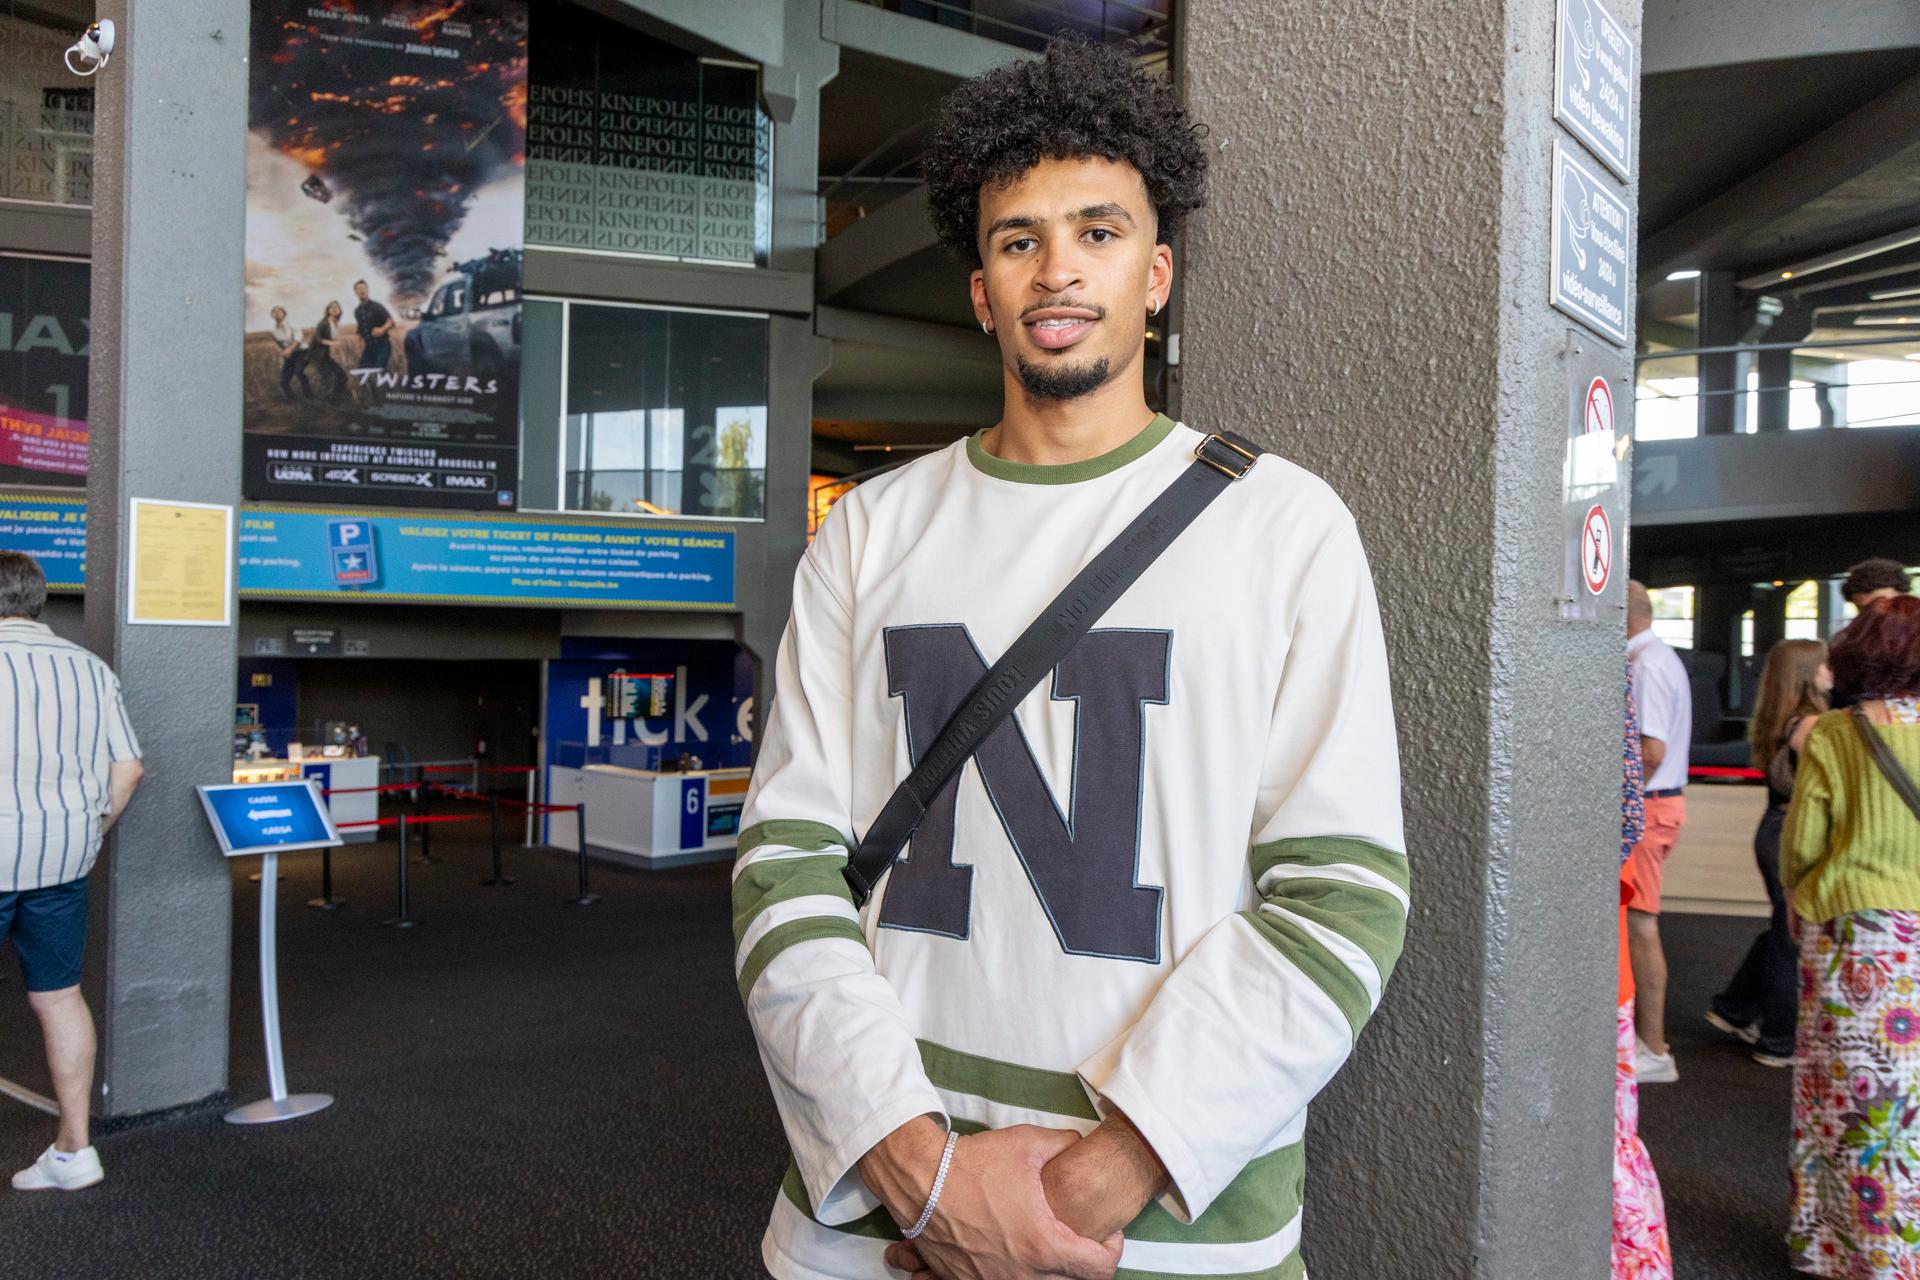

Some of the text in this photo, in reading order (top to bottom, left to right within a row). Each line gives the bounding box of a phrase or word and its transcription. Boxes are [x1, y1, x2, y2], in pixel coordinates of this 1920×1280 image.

[600, 93, 698, 119] KINEPOLIS
[1568, 83, 1591, 120] video
[599, 131, 697, 157] KINEPOLIS
[598, 172, 696, 197] KINEPOLIS
[597, 210, 694, 237] KINEPOLIS
[349, 368, 498, 395] TWISTERS
[46, 383, 70, 432] 1
[331, 443, 436, 460] EXPERIENCE TWISTERS
[689, 425, 718, 466] 2
[291, 450, 317, 462] MORE
[371, 454, 385, 465] AT
[386, 456, 436, 468] KINEPOLIS
[437, 458, 484, 470] BRUSSELS
[273, 469, 315, 481] ULTRA
[324, 467, 361, 484] 4DX
[445, 475, 488, 488] IMAX
[339, 524, 361, 546] P
[450, 528, 490, 540] VOTRE
[492, 529, 531, 541] TICKET
[533, 531, 549, 541] DE
[551, 532, 601, 544] PARKING
[603, 534, 641, 545] AVANT
[643, 535, 680, 547] VOTRE
[682, 535, 726, 549] SÉANCE
[448, 541, 475, 551] Avant
[556, 545, 585, 555] valider
[586, 546, 609, 556] votre
[610, 546, 634, 557] ticket
[635, 547, 646, 557] de
[647, 548, 680, 561] parking
[576, 569, 607, 578] caisses
[608, 569, 665, 581] automatiques
[666, 571, 678, 581] du
[679, 572, 713, 584] parking.
[686, 788, 699, 815] 6
[878, 622, 1174, 966] N
